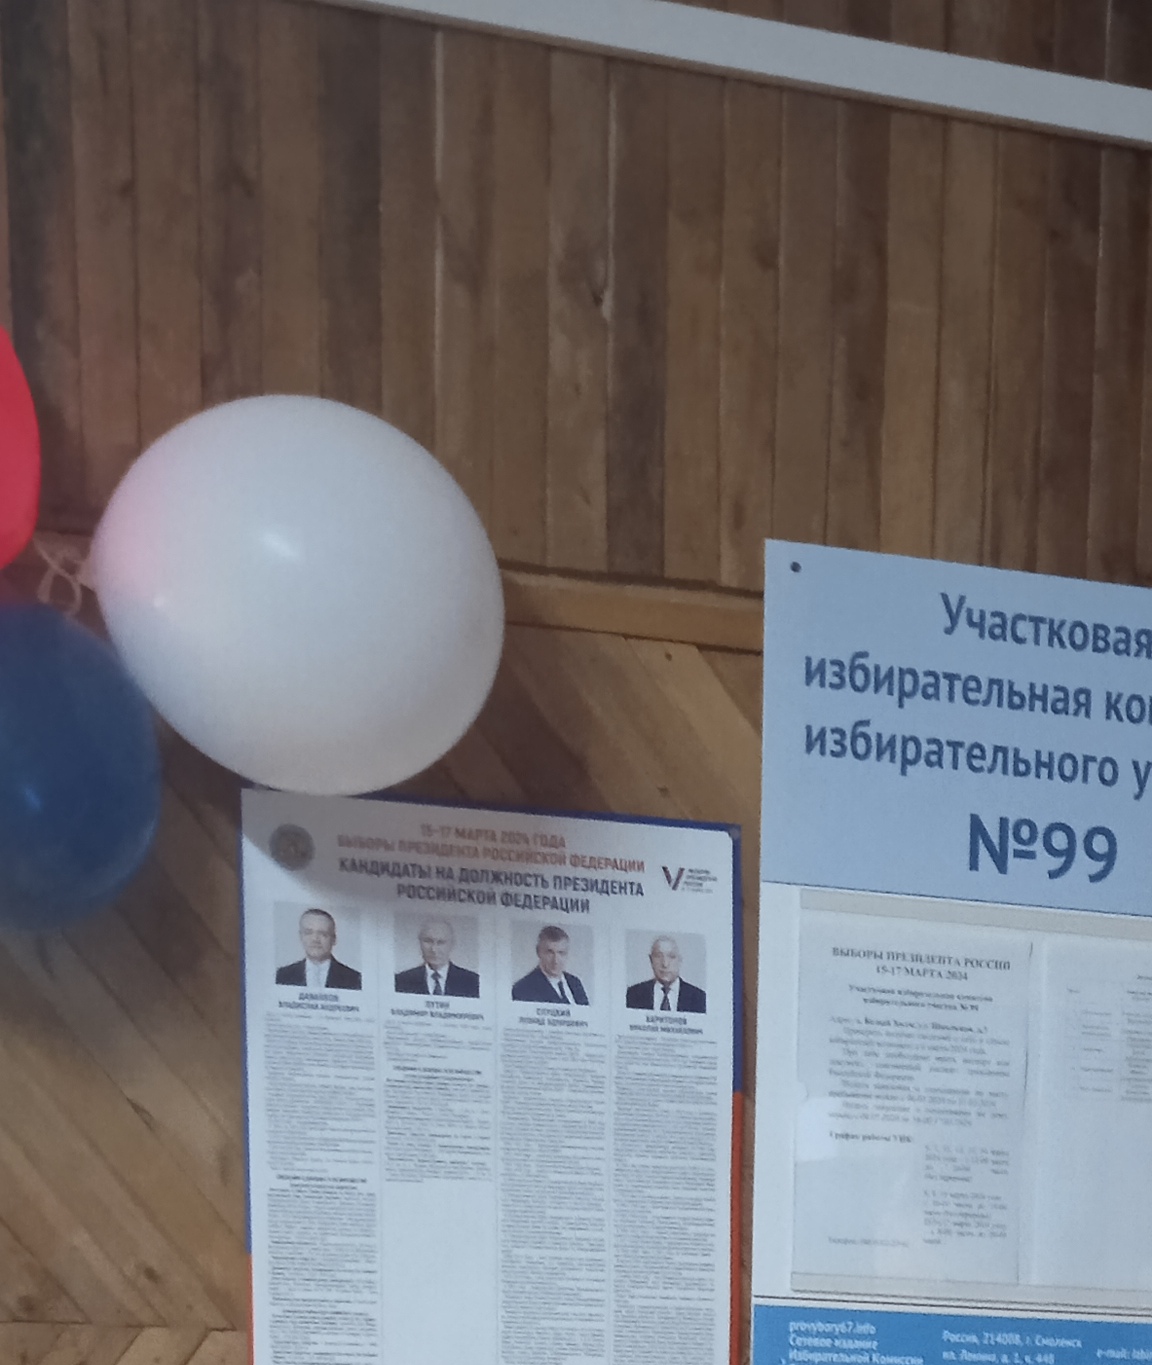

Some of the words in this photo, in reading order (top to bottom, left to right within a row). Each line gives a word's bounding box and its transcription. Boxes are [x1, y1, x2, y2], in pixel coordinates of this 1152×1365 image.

[804, 652, 1092, 719] избирательная
[804, 719, 1119, 788] избирательного
[533, 833, 567, 849] ГОДА
[968, 813, 1118, 883] №99
[483, 846, 567, 866] РОССИЙСКОЙ
[569, 853, 645, 873] ФЕДЕРАЦИИ
[338, 857, 432, 879] КАНДИДАТЫ
[435, 866, 455, 880] НА
[459, 867, 549, 889] ДОЛЖНОСТЬ
[553, 875, 644, 896] ПРЕЗИДЕНТА
[397, 883, 497, 905] РОССИЙСКОЙ
[500, 892, 590, 914] ФЕДЕРАЦИИ
[833, 947, 883, 961] ВЫБОРЫ
[886, 951, 961, 968] ПРЕЗИДЕНТА
[964, 958, 1011, 971] РОССИИ
[876, 965, 902, 976] 15-17
[904, 966, 943, 979] МАРТА
[1035, 1334, 1082, 1348] Смоленск
[872, 1353, 924, 1365] Комиссии
